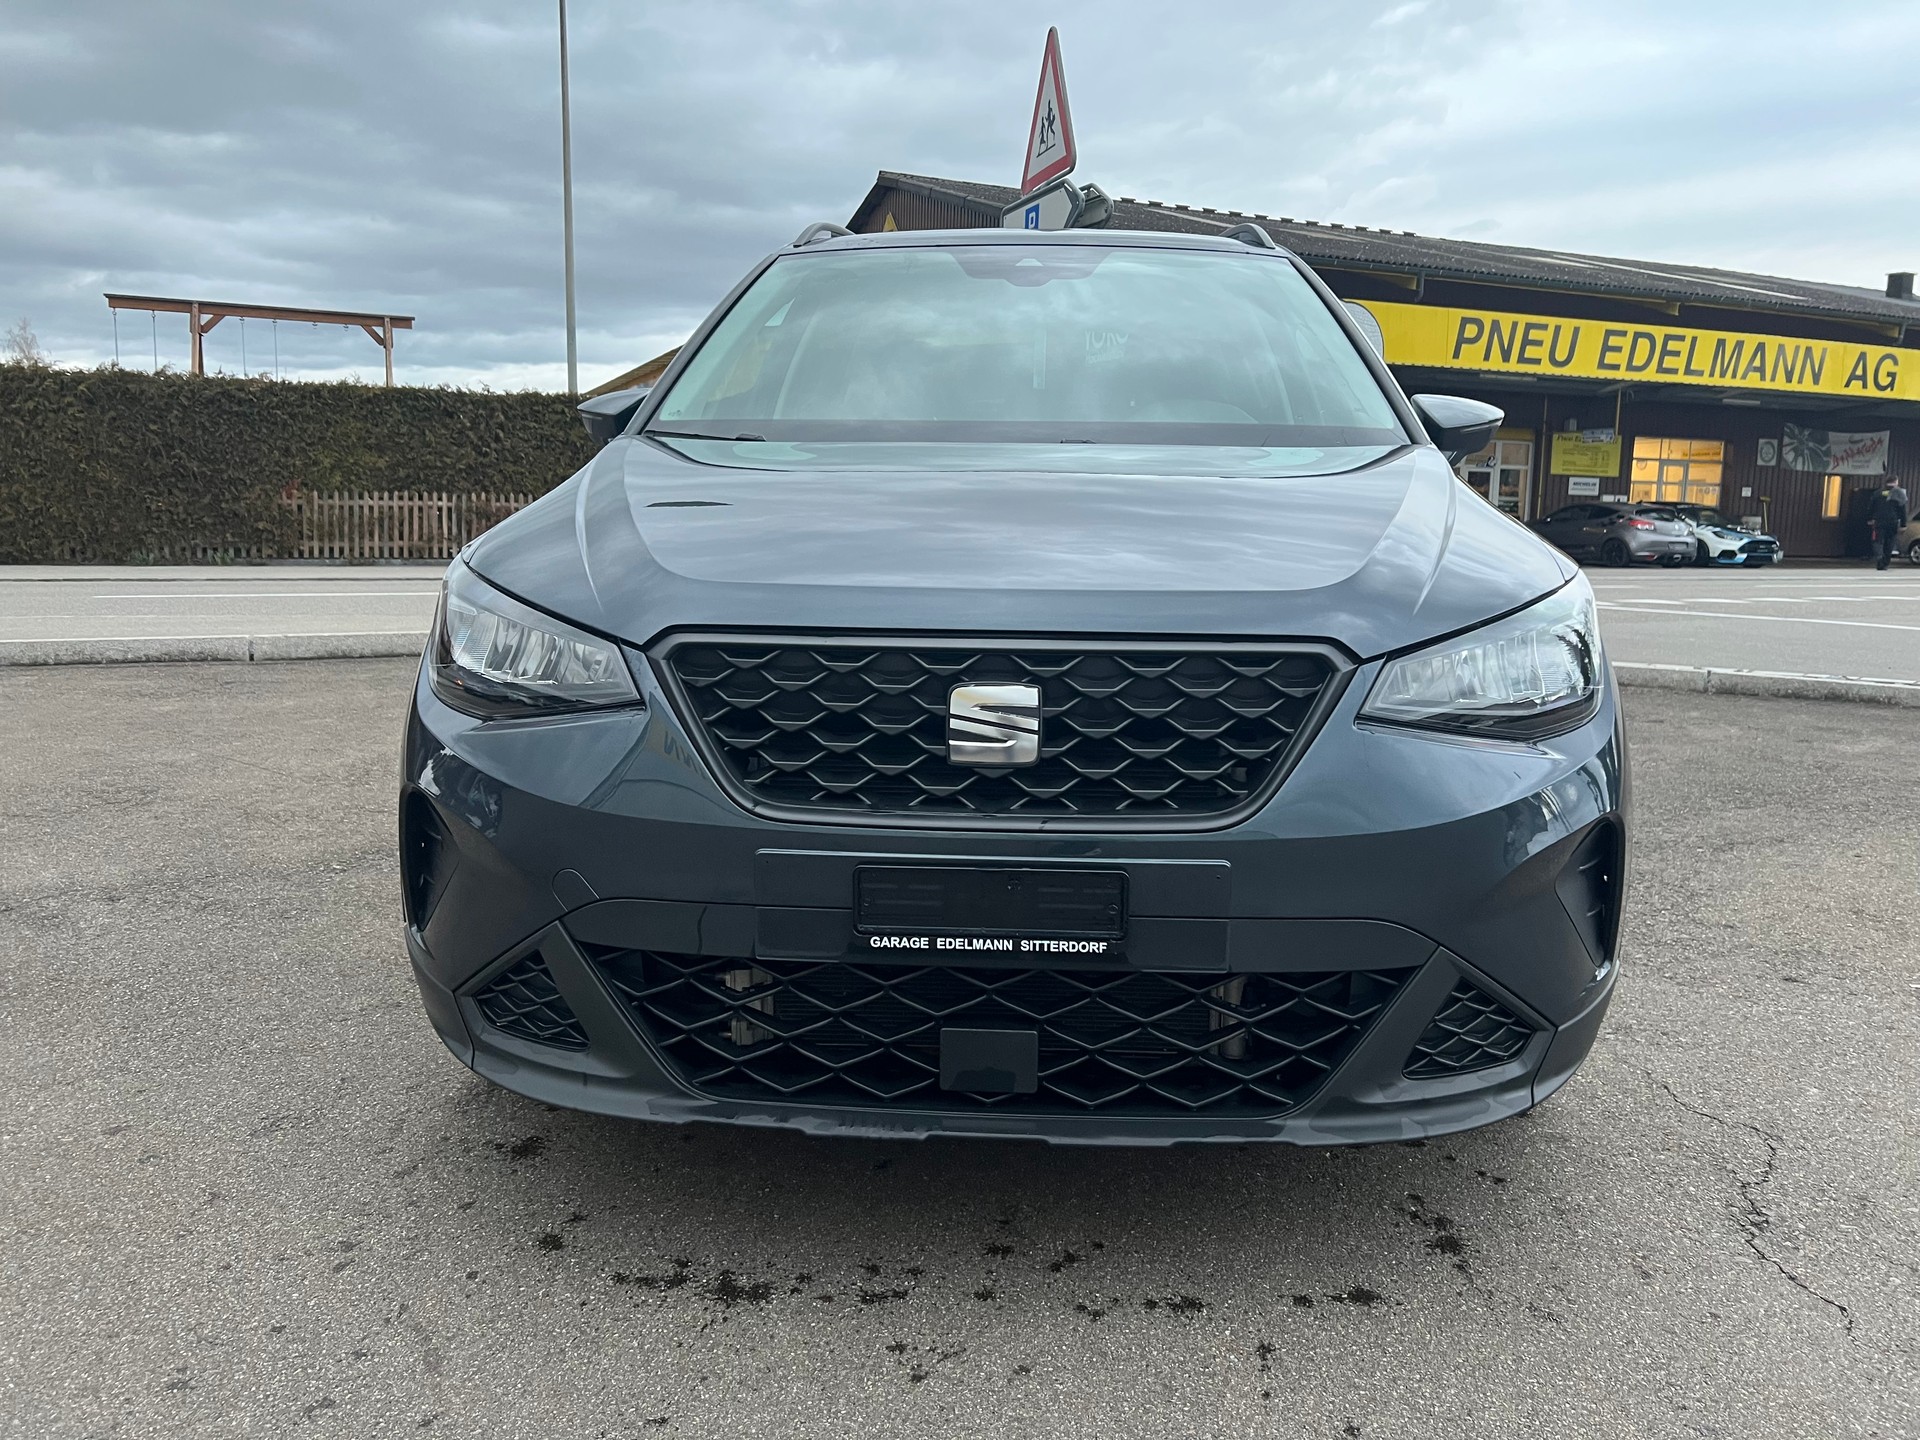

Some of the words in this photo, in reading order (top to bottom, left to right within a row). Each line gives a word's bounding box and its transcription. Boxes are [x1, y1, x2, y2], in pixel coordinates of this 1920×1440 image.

[1029, 211, 1036, 229] P
[1452, 316, 1581, 368] PNEU
[1597, 329, 1828, 386] EDELMANN
[1844, 351, 1899, 392] AG
[870, 936, 929, 949] GARAGE
[936, 938, 1013, 951] EDELMANN
[1020, 940, 1107, 953] SITTERDORF
